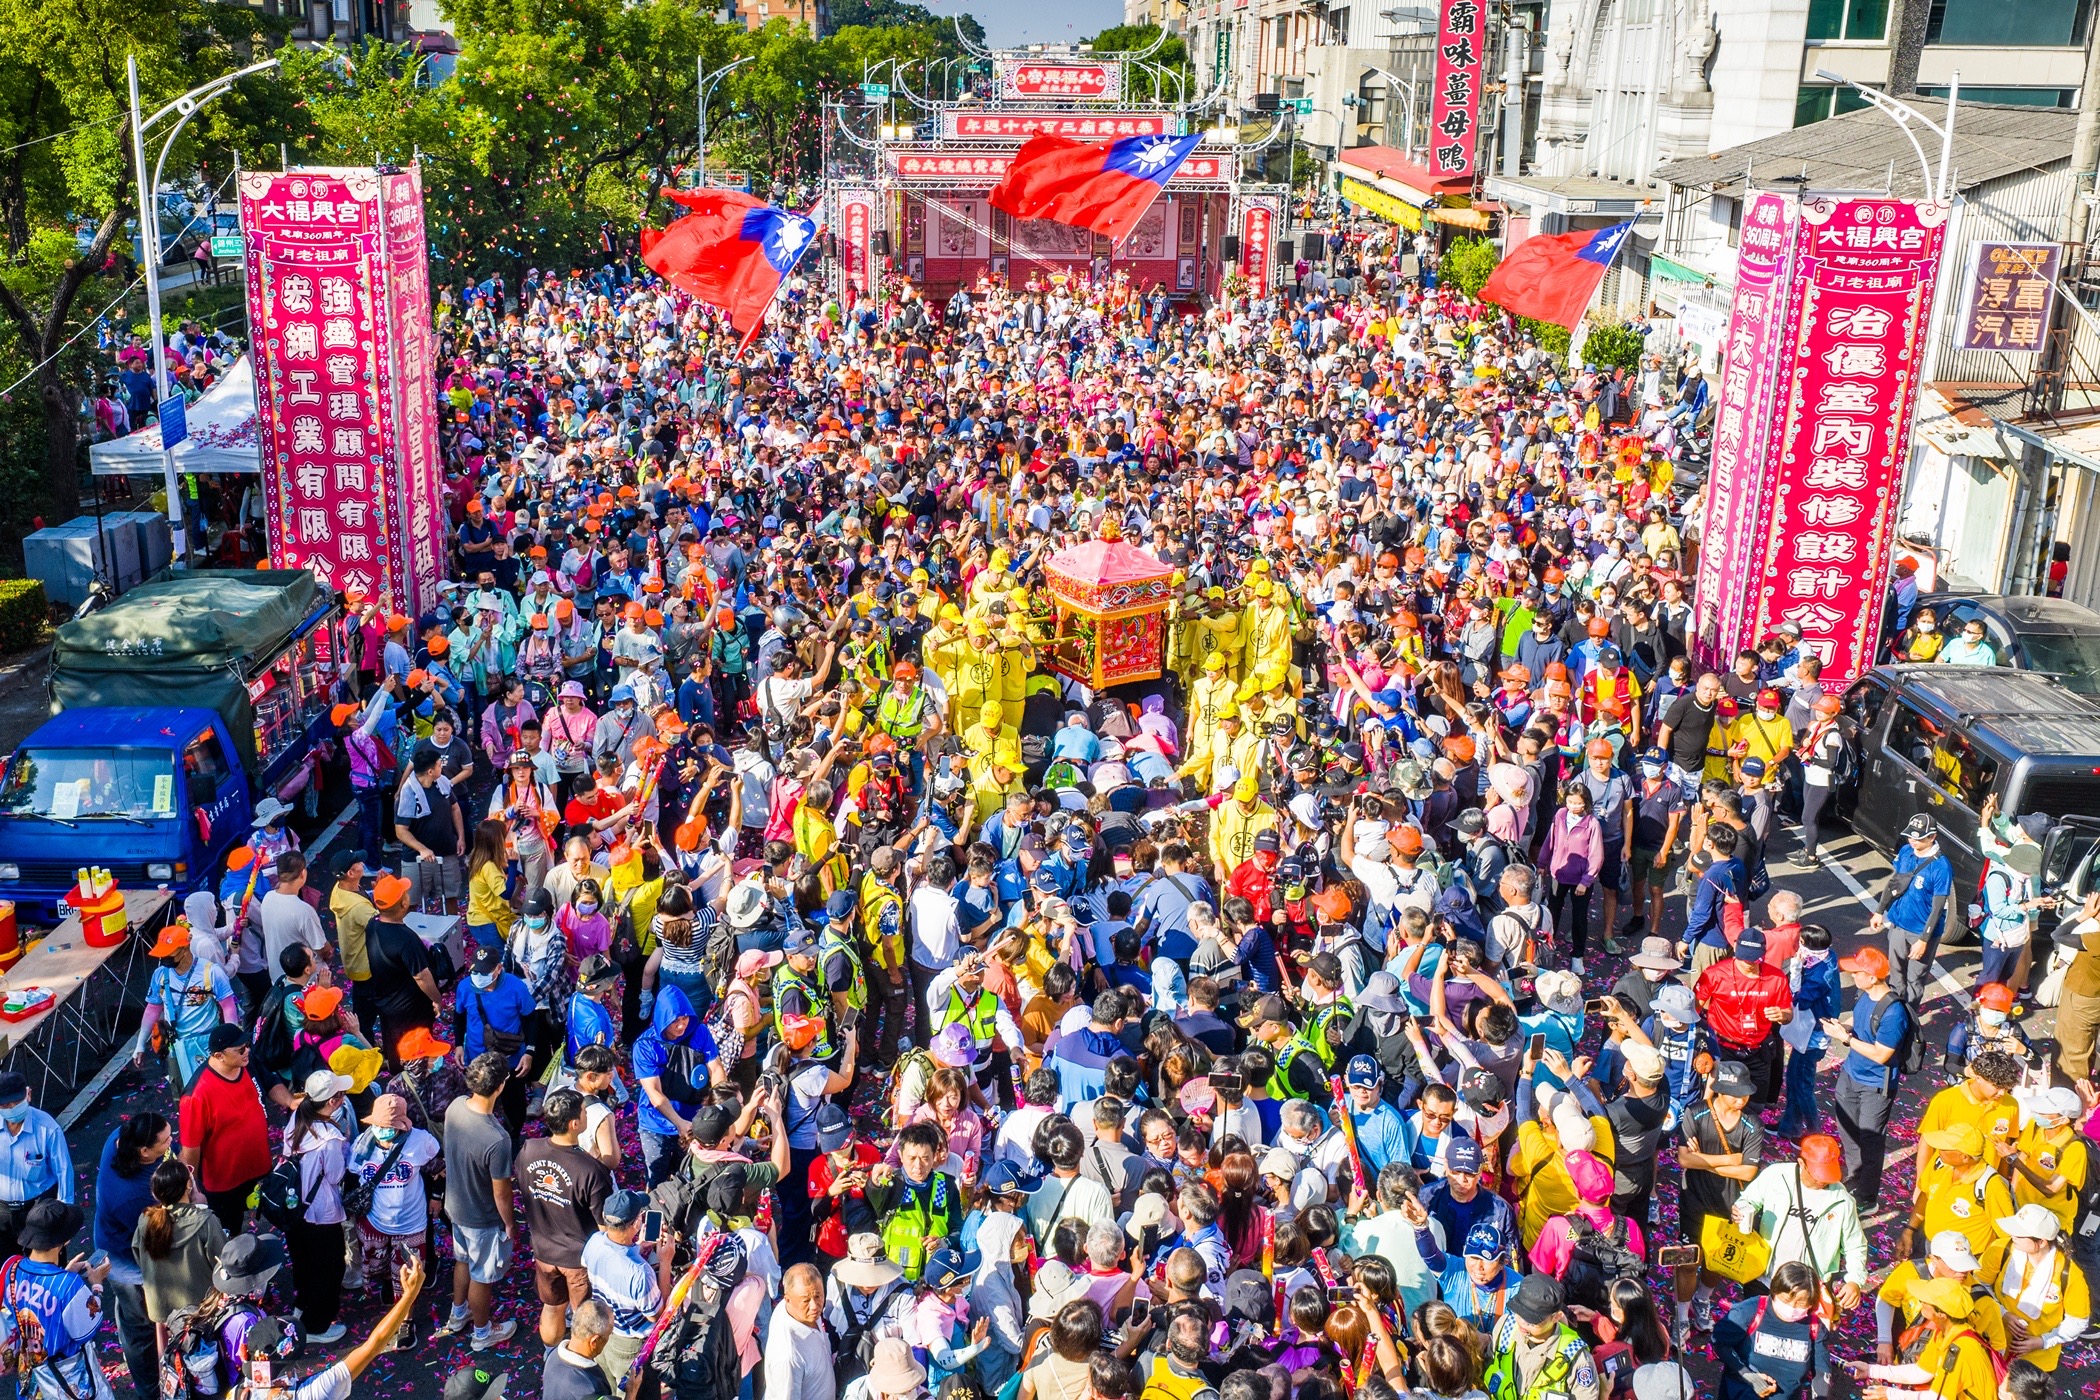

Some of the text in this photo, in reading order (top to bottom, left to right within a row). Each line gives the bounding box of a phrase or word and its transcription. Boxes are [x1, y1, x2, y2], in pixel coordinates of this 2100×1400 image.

[1027, 68, 1095, 85] 大福興宮
[1438, 2, 1479, 172] 霸味薑母鴨
[261, 200, 361, 223] 大福興宮
[279, 229, 345, 240] 建廟360周年
[1744, 228, 1781, 252] 360周年
[1818, 225, 1926, 250] 大福興宮
[278, 248, 349, 262] 月老祖廟
[1834, 254, 1903, 267] 建廟360周年
[1827, 275, 1903, 290] 月老祖廟
[1978, 277, 2049, 310] 淳富
[1971, 314, 2041, 347] 汽車
[319, 276, 375, 628] 強盛管理顧問有限公
[527, 1160, 573, 1187] POINT ROBERTS
